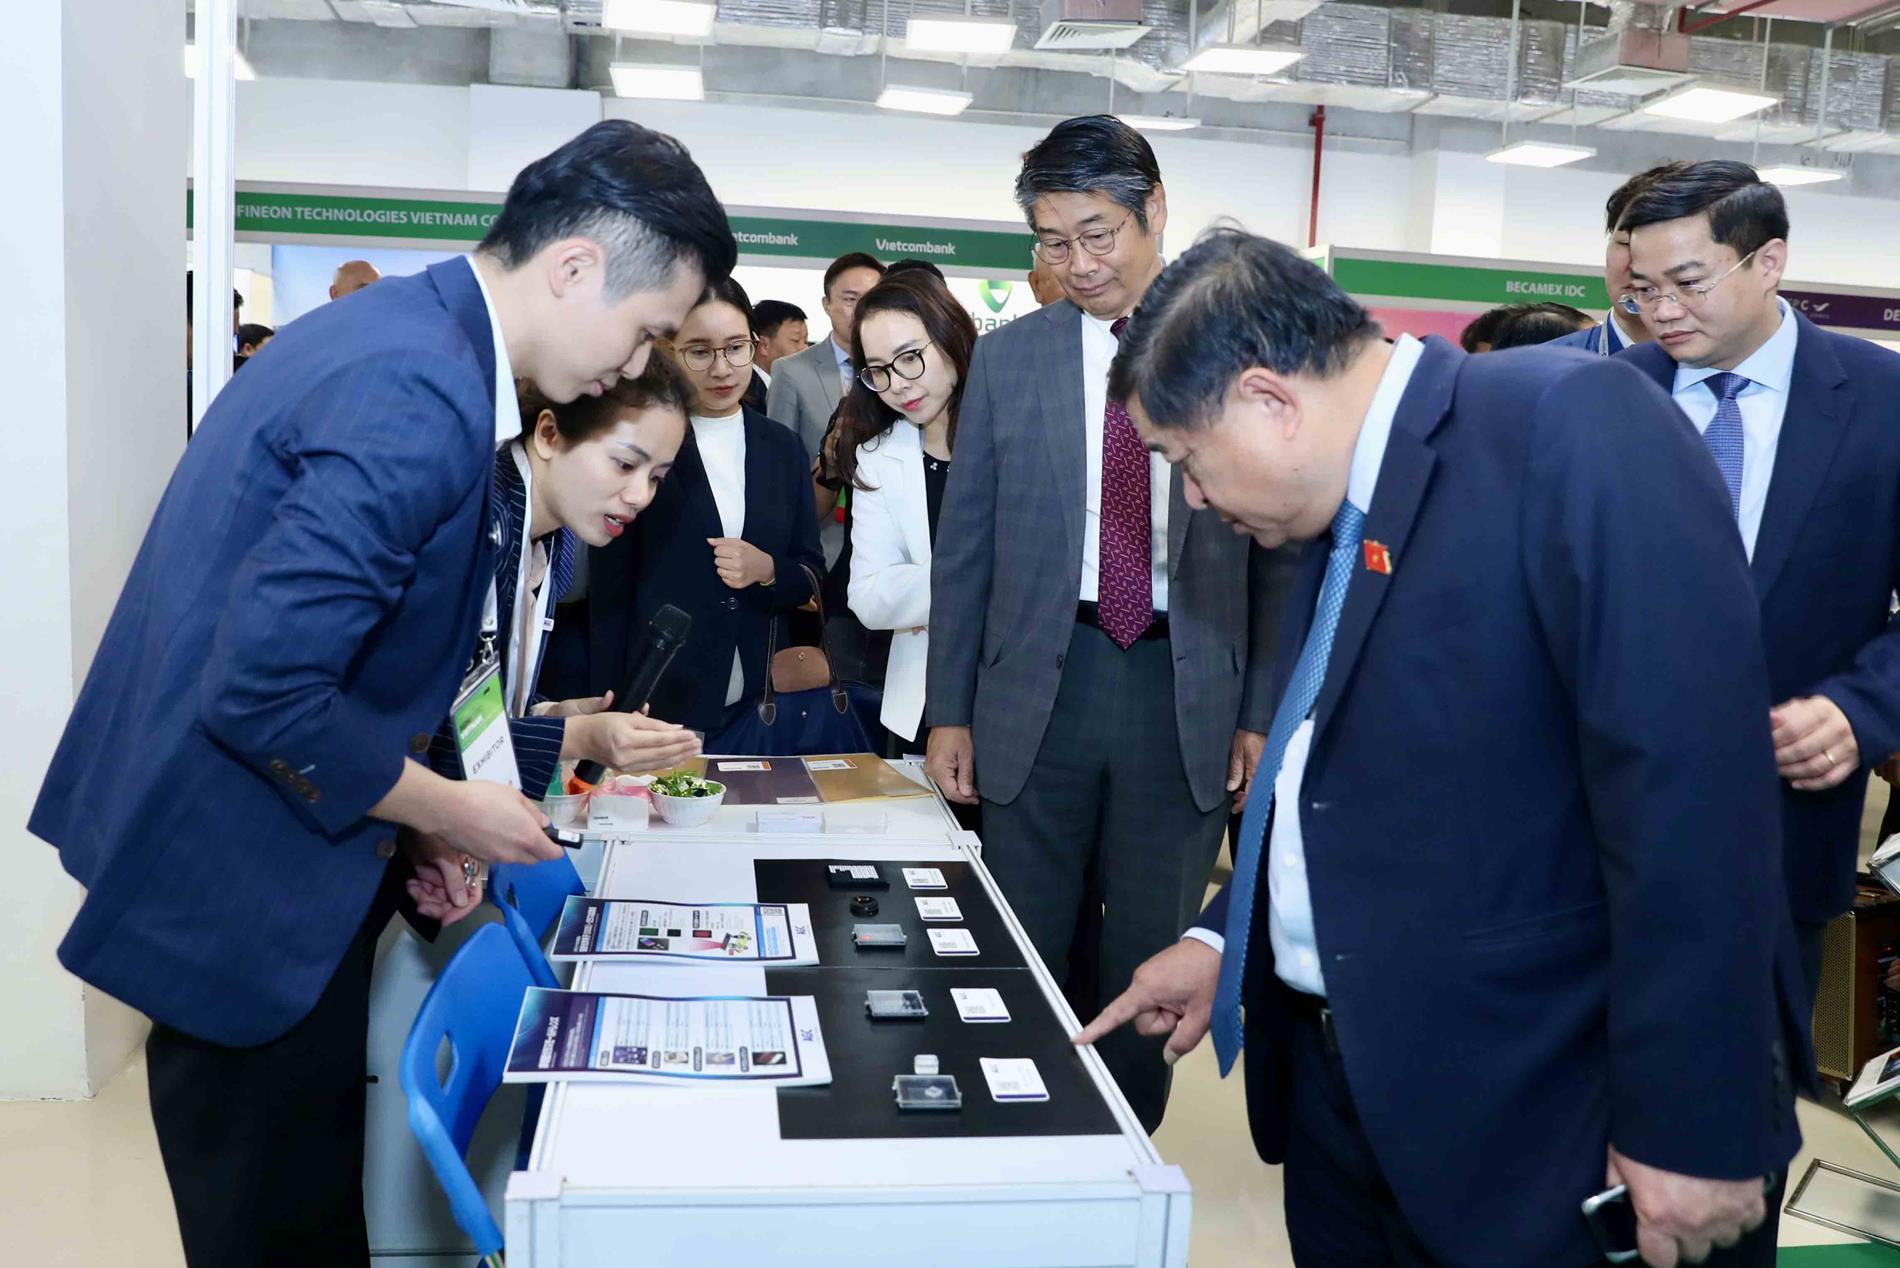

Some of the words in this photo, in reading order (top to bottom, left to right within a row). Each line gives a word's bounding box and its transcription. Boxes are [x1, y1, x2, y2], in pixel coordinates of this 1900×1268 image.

[236, 205, 292, 219] FINEON
[295, 207, 407, 224] TECHNOLOGIES
[410, 211, 478, 226] VIETNAM
[875, 238, 956, 255] Vietcombank
[1505, 281, 1563, 296] BECAMEX
[1564, 284, 1586, 298] IDC
